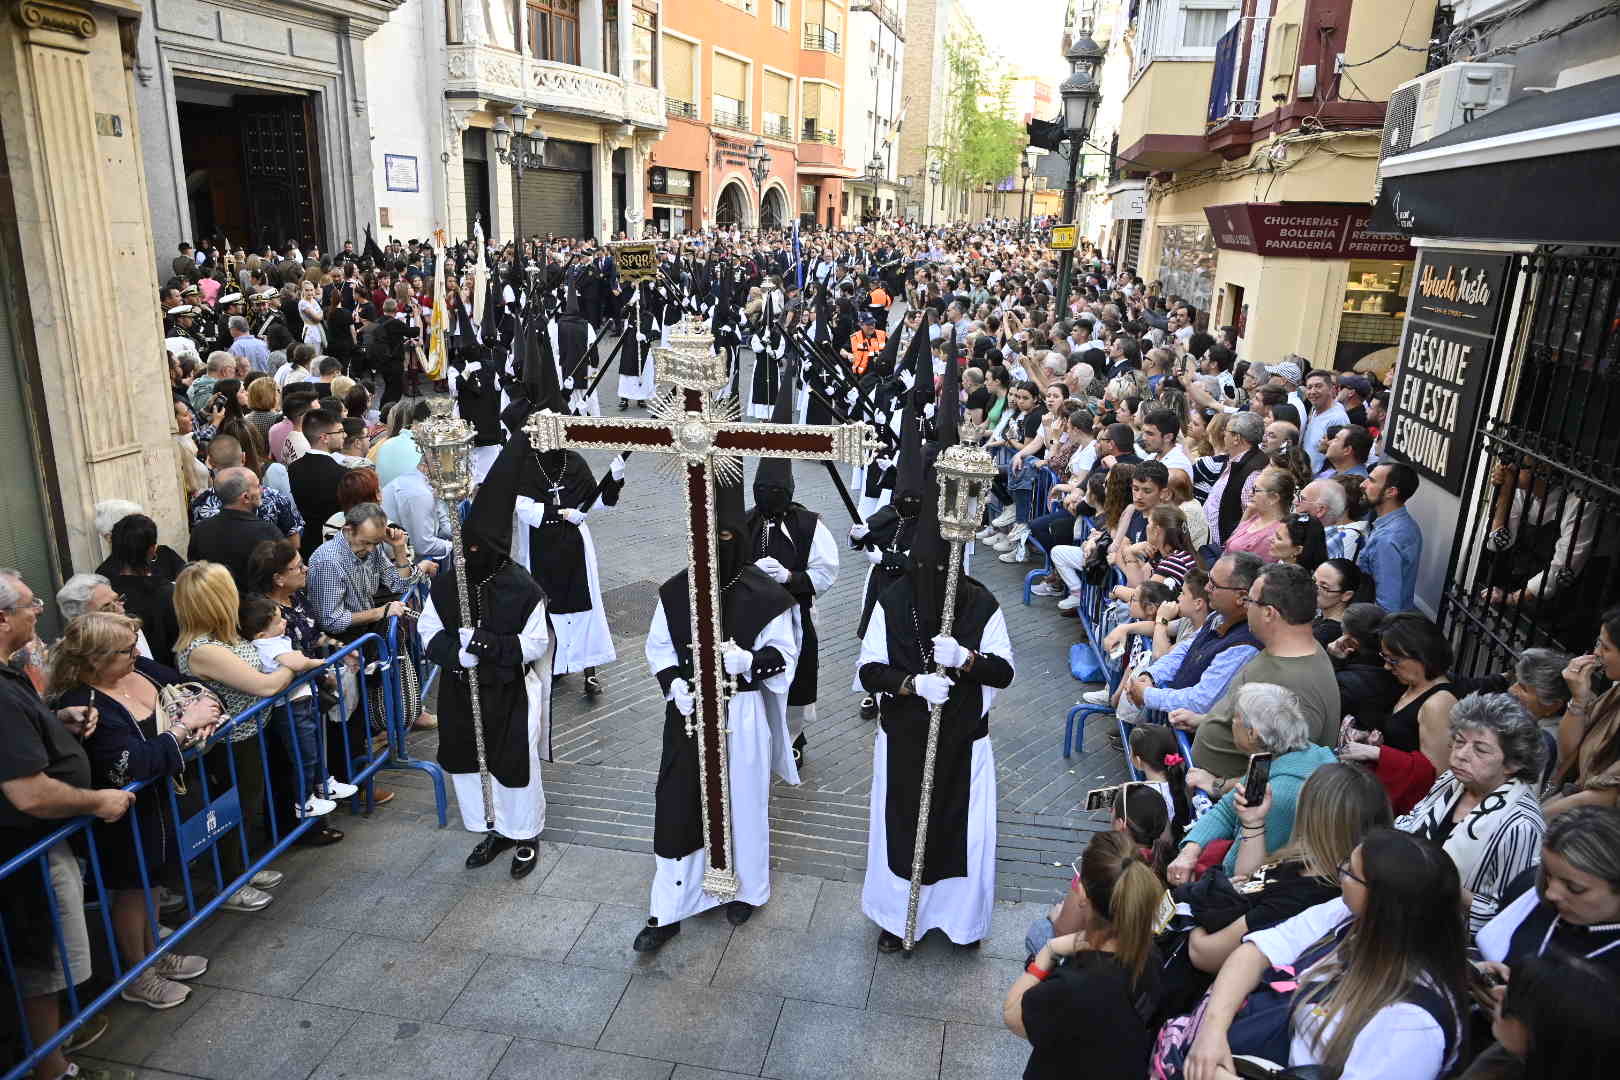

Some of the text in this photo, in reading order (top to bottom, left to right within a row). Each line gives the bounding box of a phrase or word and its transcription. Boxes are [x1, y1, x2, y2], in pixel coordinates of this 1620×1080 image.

[1264, 216, 1340, 227] CHUCHERÍAS
[1280, 227, 1336, 238] BOLLERÍA
[1349, 242, 1406, 253] PERRITOS
[1419, 264, 1490, 306] Abuela Justa
[1407, 329, 1472, 386] BÉSAME
[1400, 374, 1460, 432] EN ESTA
[1392, 414, 1450, 477] ESQUINA
